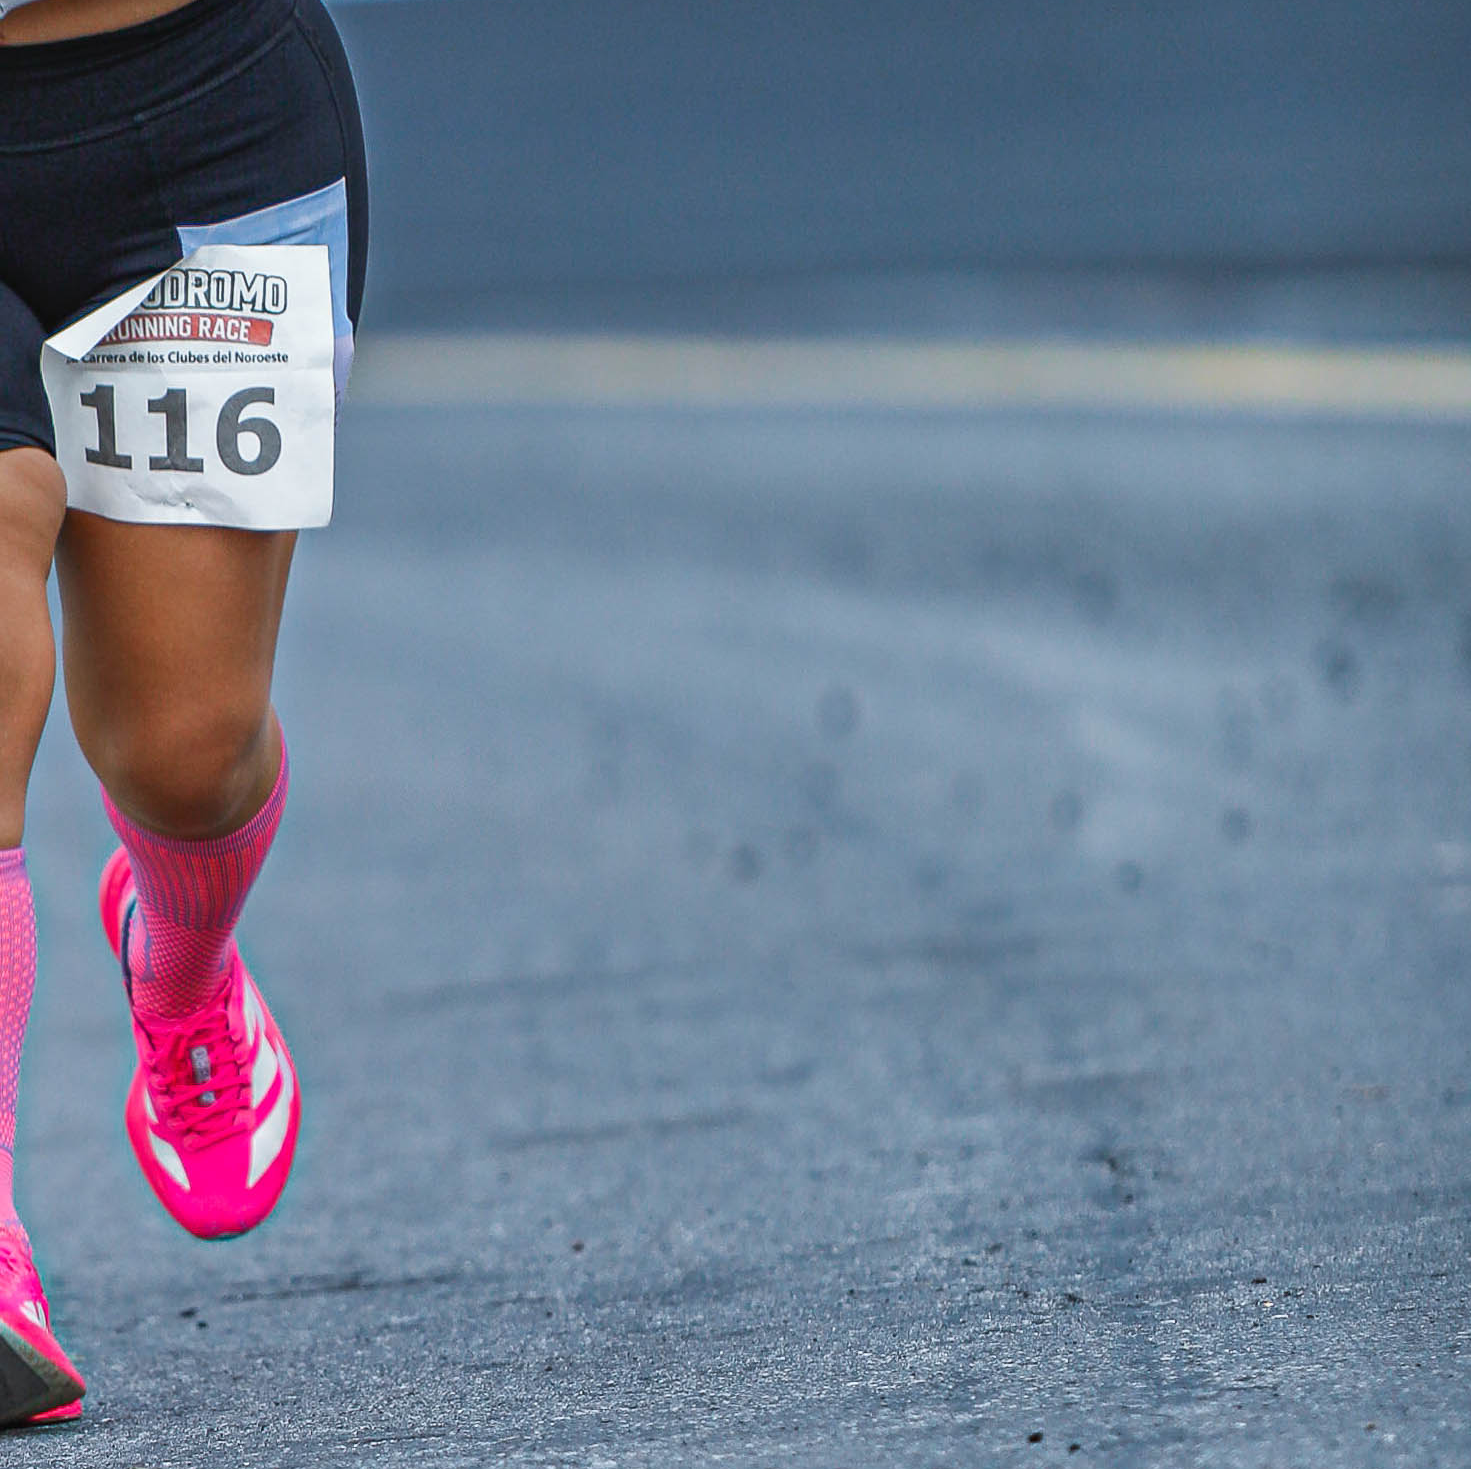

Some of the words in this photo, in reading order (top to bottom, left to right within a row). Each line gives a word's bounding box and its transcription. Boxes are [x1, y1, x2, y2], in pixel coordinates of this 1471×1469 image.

[198, 316, 252, 342] RACE
[81, 352, 127, 364] Carrera
[128, 350, 145, 363] de
[147, 351, 165, 364] los
[167, 350, 210, 364] Clubes
[212, 350, 232, 364] del
[234, 351, 289, 364] Noroeste
[79, 383, 283, 477] 116
